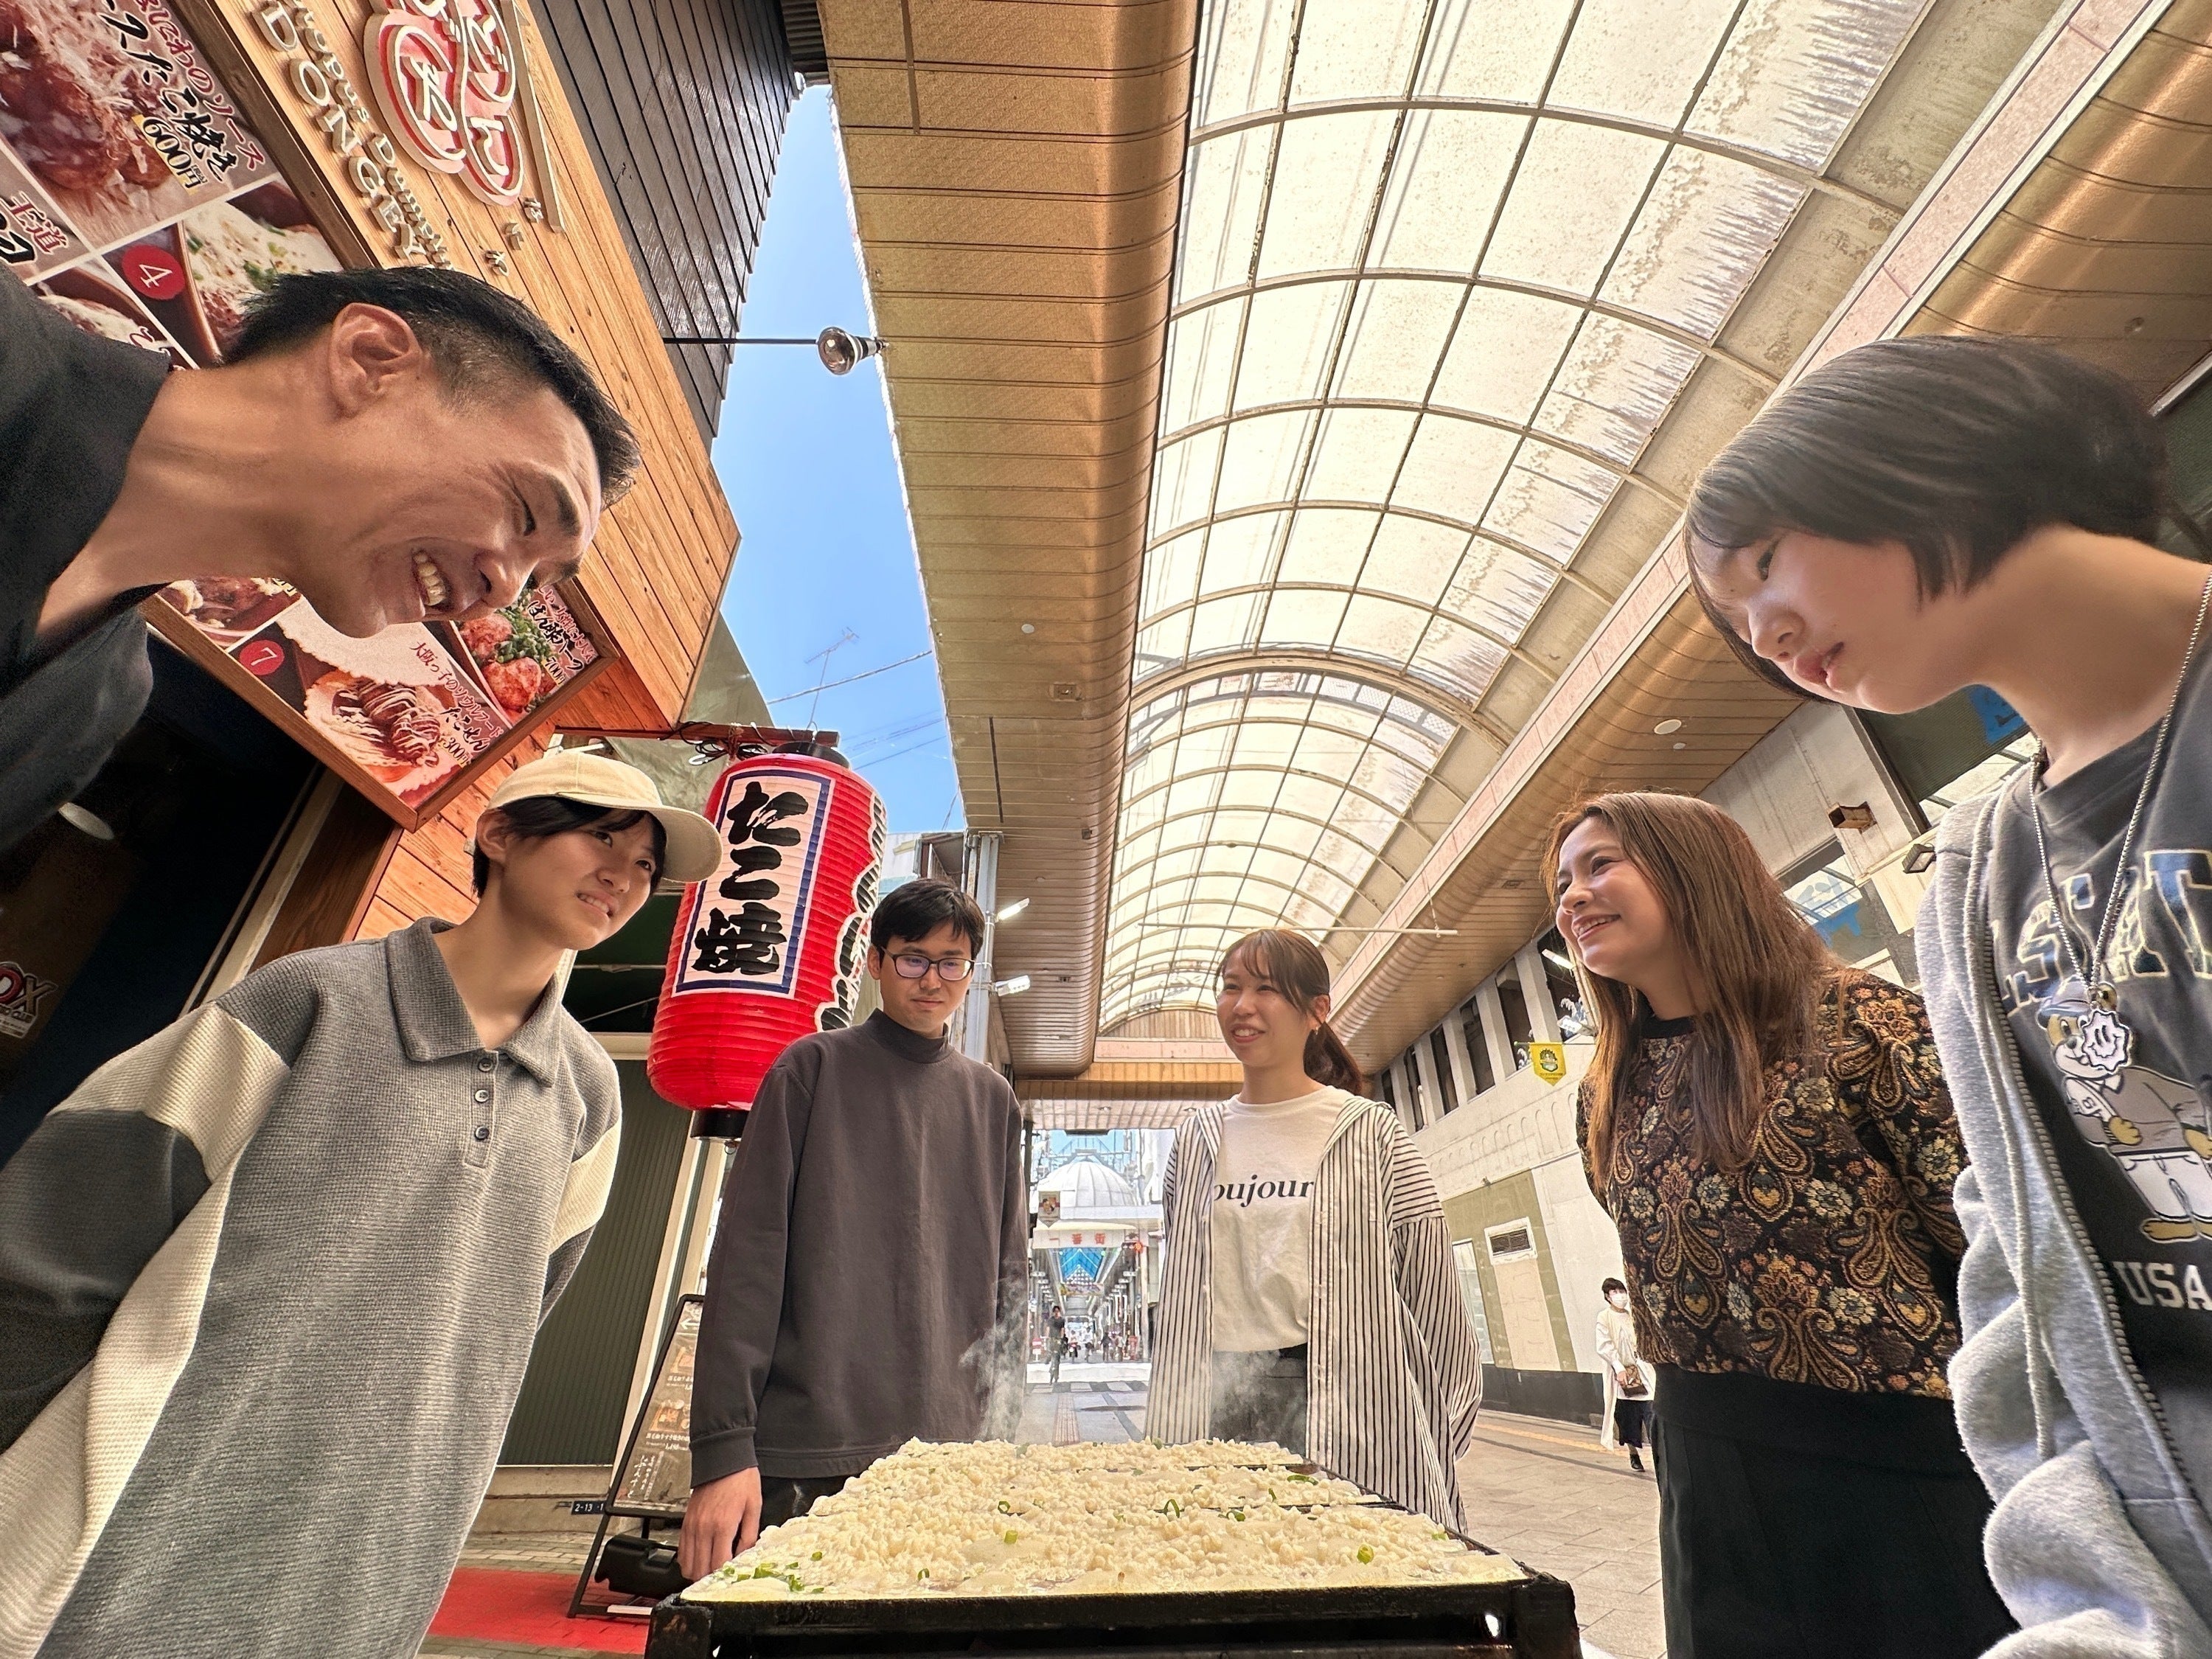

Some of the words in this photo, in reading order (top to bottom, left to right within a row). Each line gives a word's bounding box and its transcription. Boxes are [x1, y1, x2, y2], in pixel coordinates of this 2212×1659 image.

[142, 117, 202, 189] 600円
[260, 1, 437, 270] DONGEY
[0, 191, 68, 254] 王道
[372, 133, 454, 270] Dumpli
[139, 263, 173, 288] 4
[251, 647, 277, 666] 7
[408, 641, 505, 740] 大阪っ子のソウルフード
[440, 707, 490, 753] たこせん
[442, 737, 470, 766] 300円
[691, 781, 808, 976] たこ焼
[2112, 1261, 2212, 1311] USA
